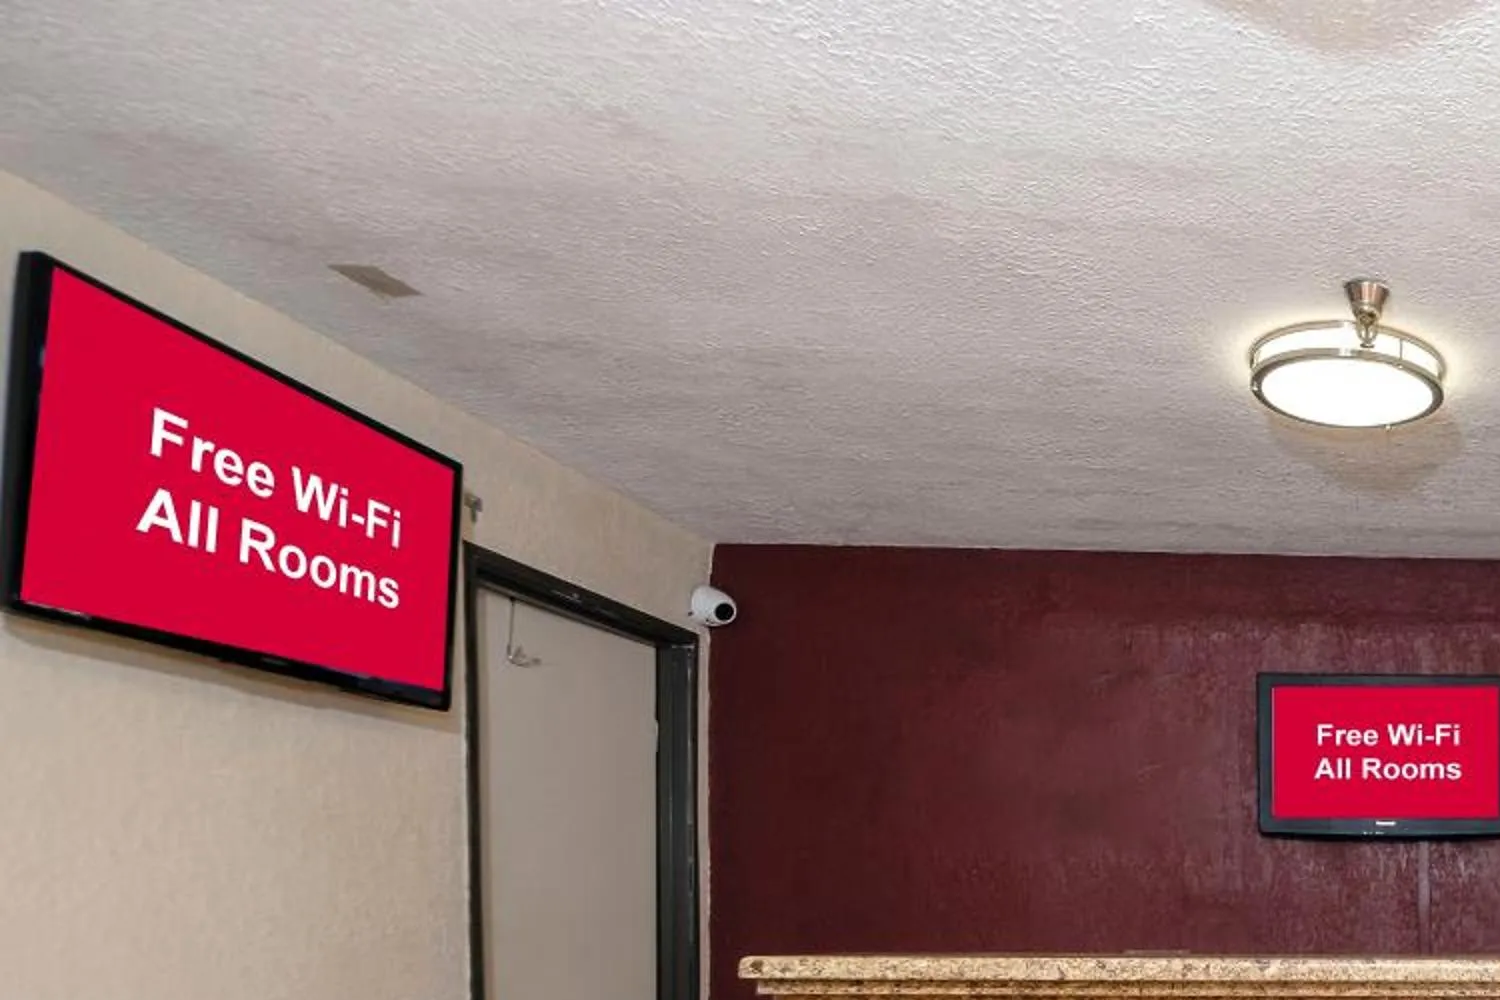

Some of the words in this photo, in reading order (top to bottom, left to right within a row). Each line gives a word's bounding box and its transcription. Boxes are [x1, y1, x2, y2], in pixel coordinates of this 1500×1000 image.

[150, 407, 275, 498] Free
[291, 466, 401, 549] Wi-Fi
[135, 487, 219, 553] All
[239, 517, 400, 609] Rooms
[1314, 757, 1351, 780] All
[1361, 757, 1462, 780] Rooms
[1316, 723, 1379, 746] Free
[1387, 723, 1460, 746] Wi-Fi
